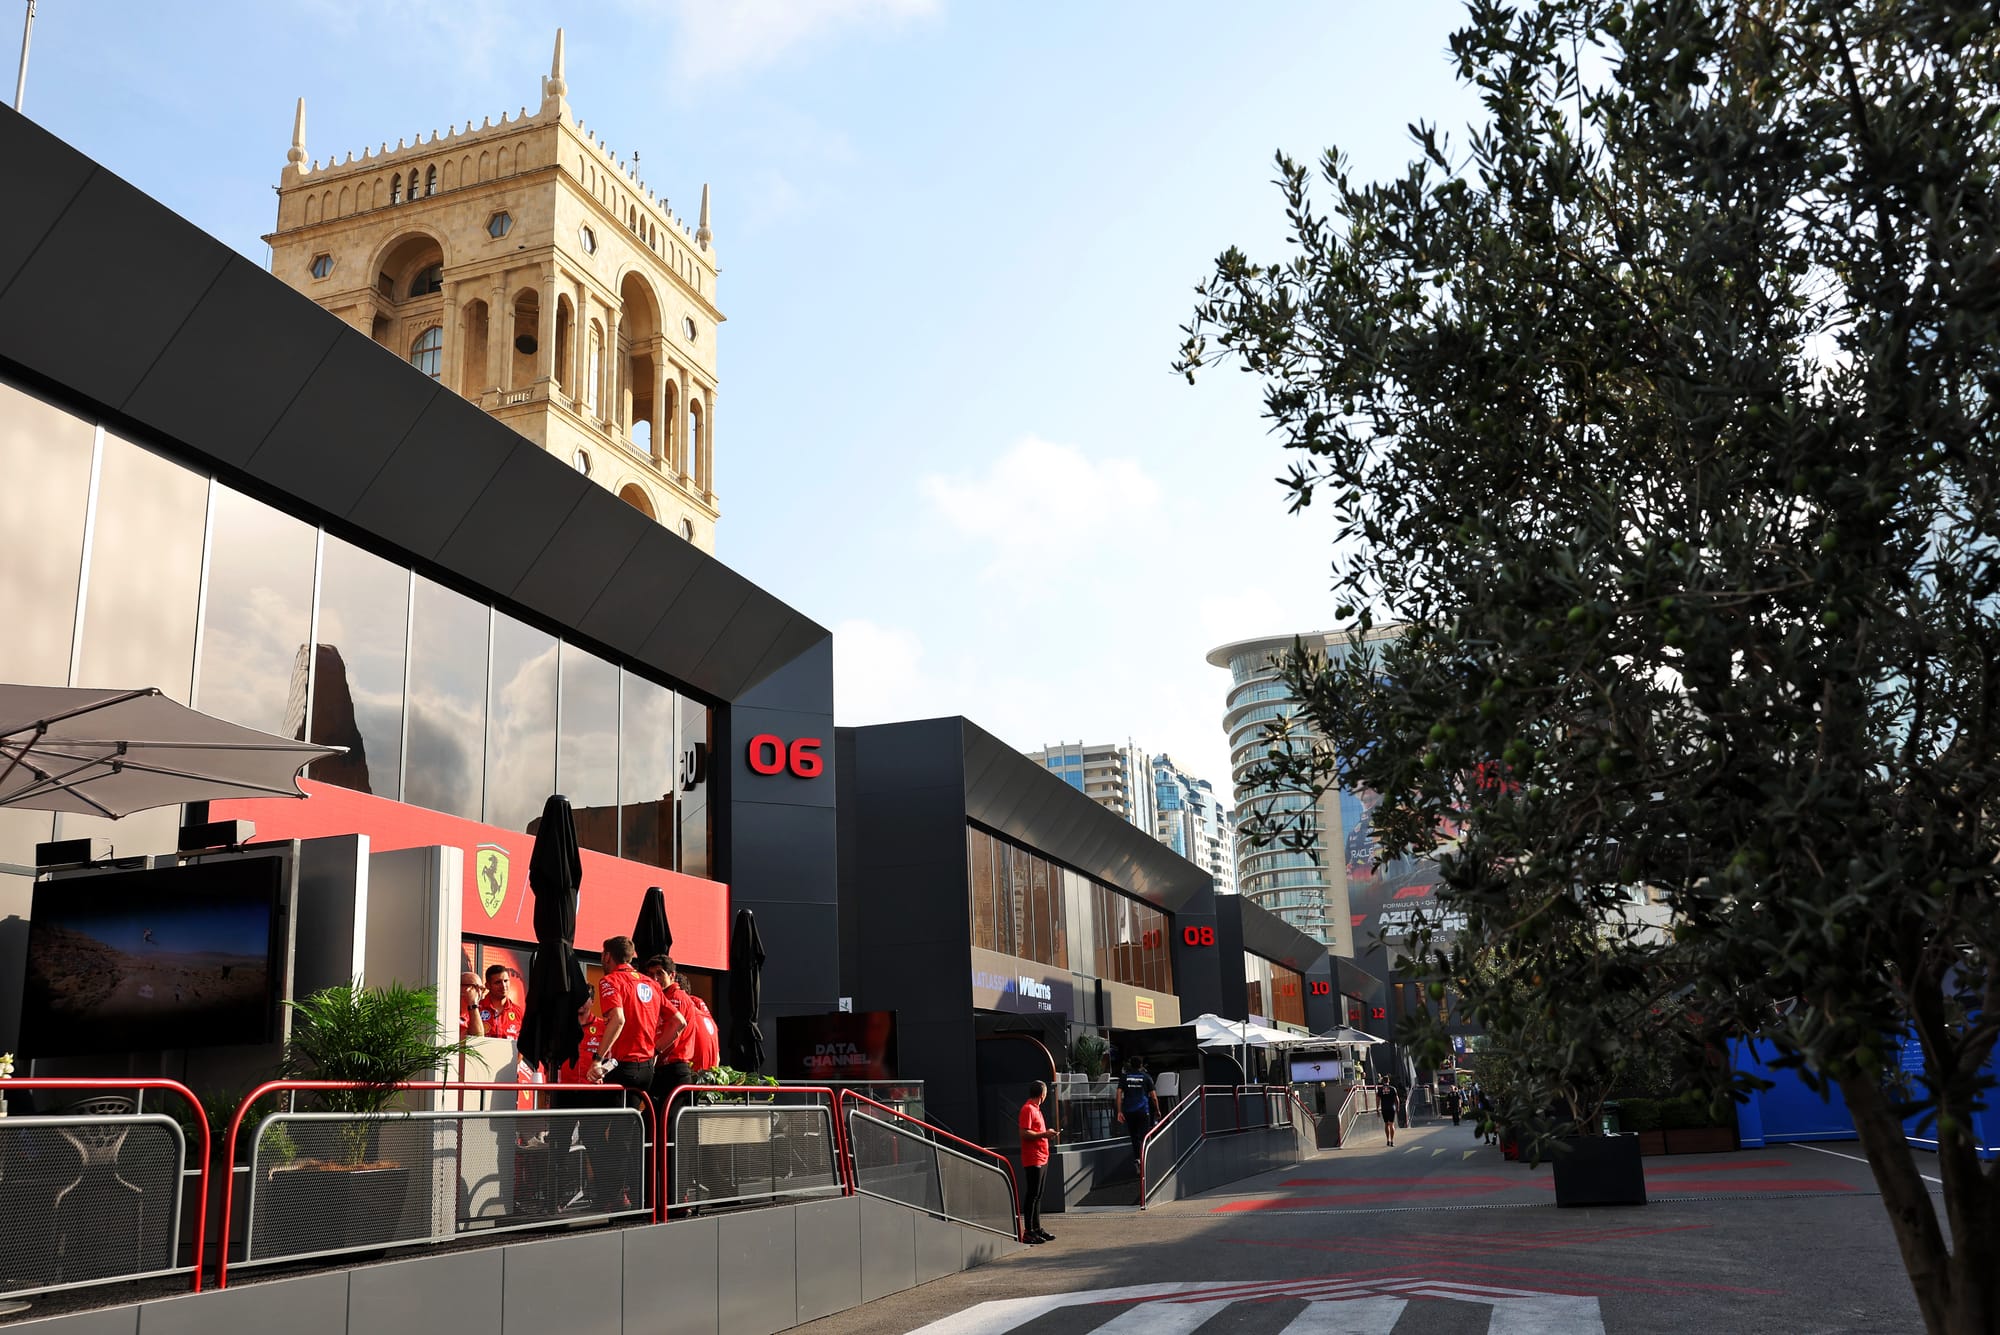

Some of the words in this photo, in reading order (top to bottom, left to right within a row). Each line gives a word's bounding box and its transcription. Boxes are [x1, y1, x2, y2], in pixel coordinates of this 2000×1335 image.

[749, 733, 823, 778] 06
[1183, 925, 1215, 947] 08
[976, 971, 1015, 992] ATLASSIAN
[1019, 975, 1051, 1000] Williams
[1311, 981, 1330, 995] 10
[1372, 1007, 1386, 1019] 12
[815, 1042, 857, 1055] DATA
[803, 1053, 871, 1066] CHANNEL
